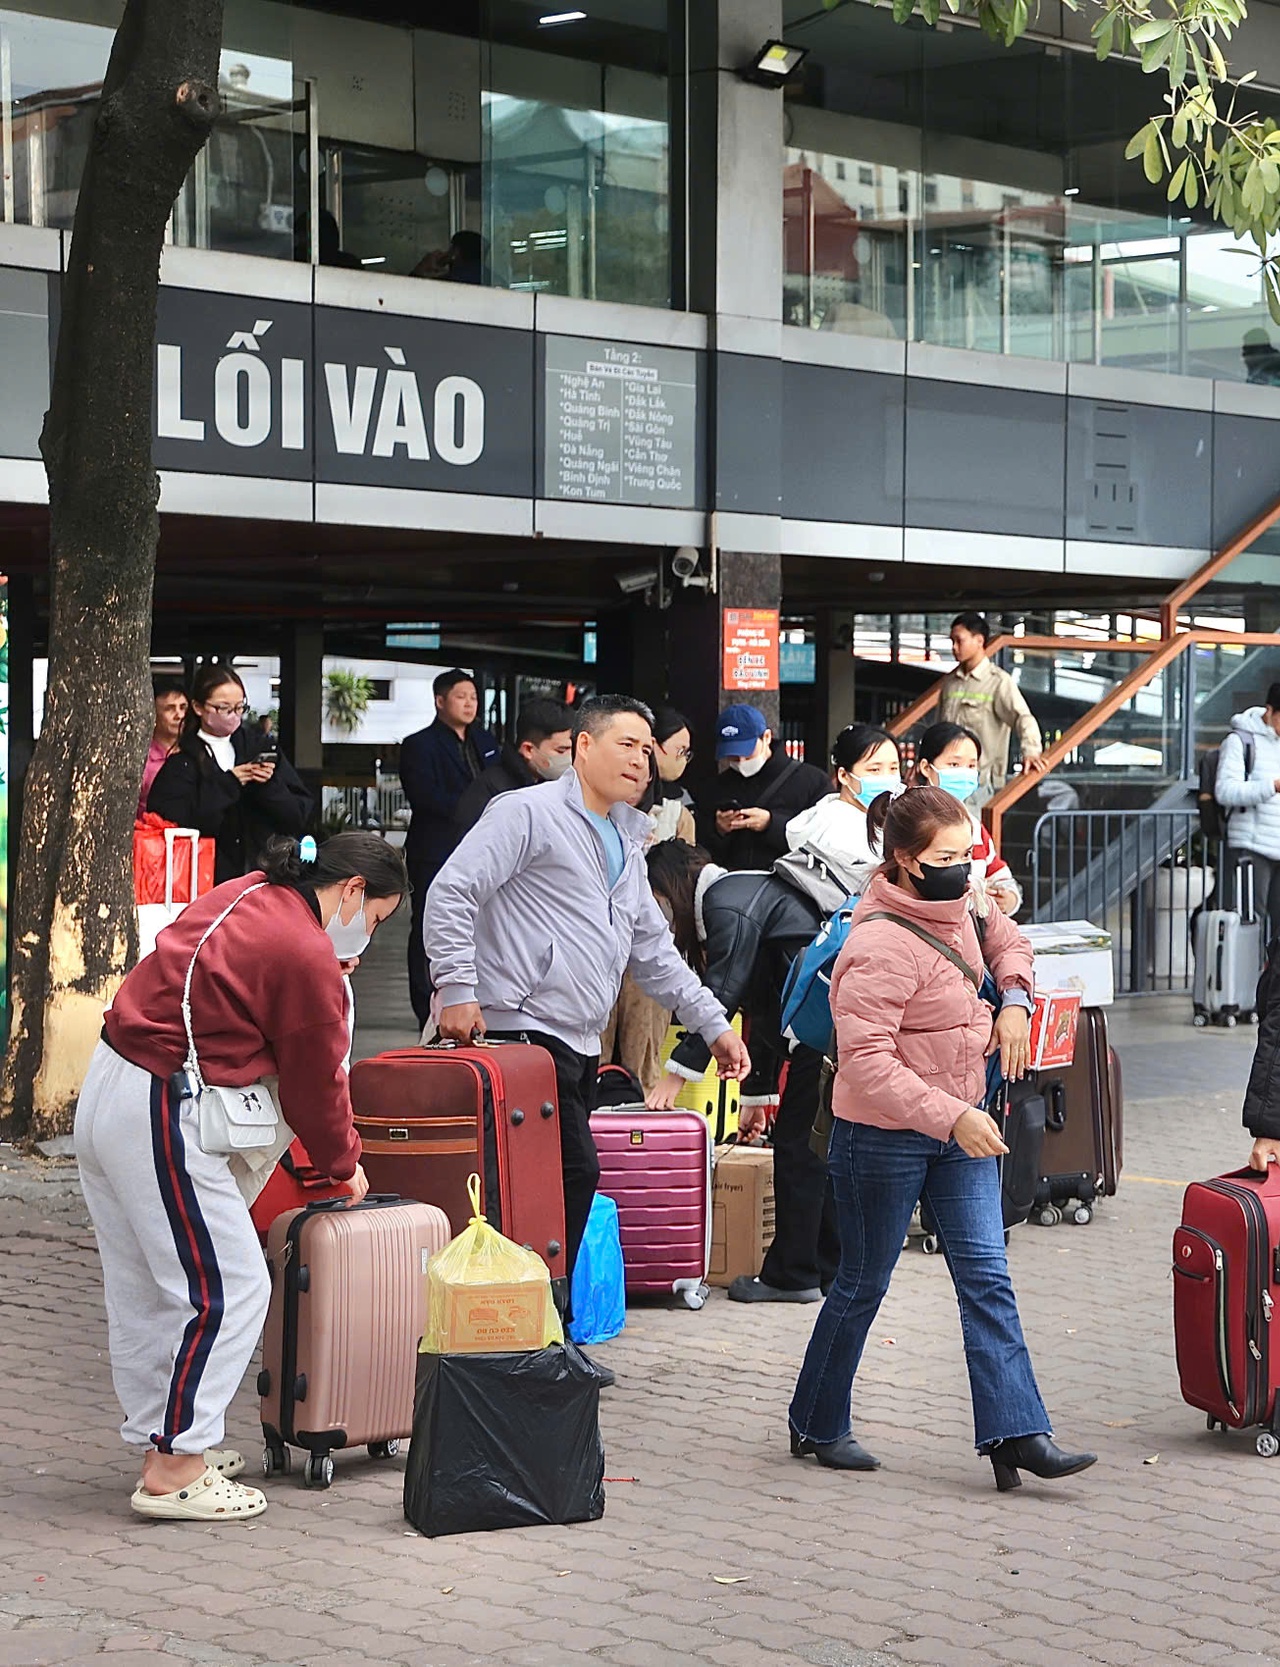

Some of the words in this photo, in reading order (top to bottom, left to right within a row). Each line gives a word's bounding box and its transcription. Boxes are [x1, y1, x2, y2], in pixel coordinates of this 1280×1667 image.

[604, 347, 630, 365] Tầng
[591, 377, 605, 389] An
[647, 383, 662, 395] Lai
[157, 319, 304, 450] LỐI
[324, 346, 485, 466] VÀO
[724, 1182, 743, 1192] fryer)
